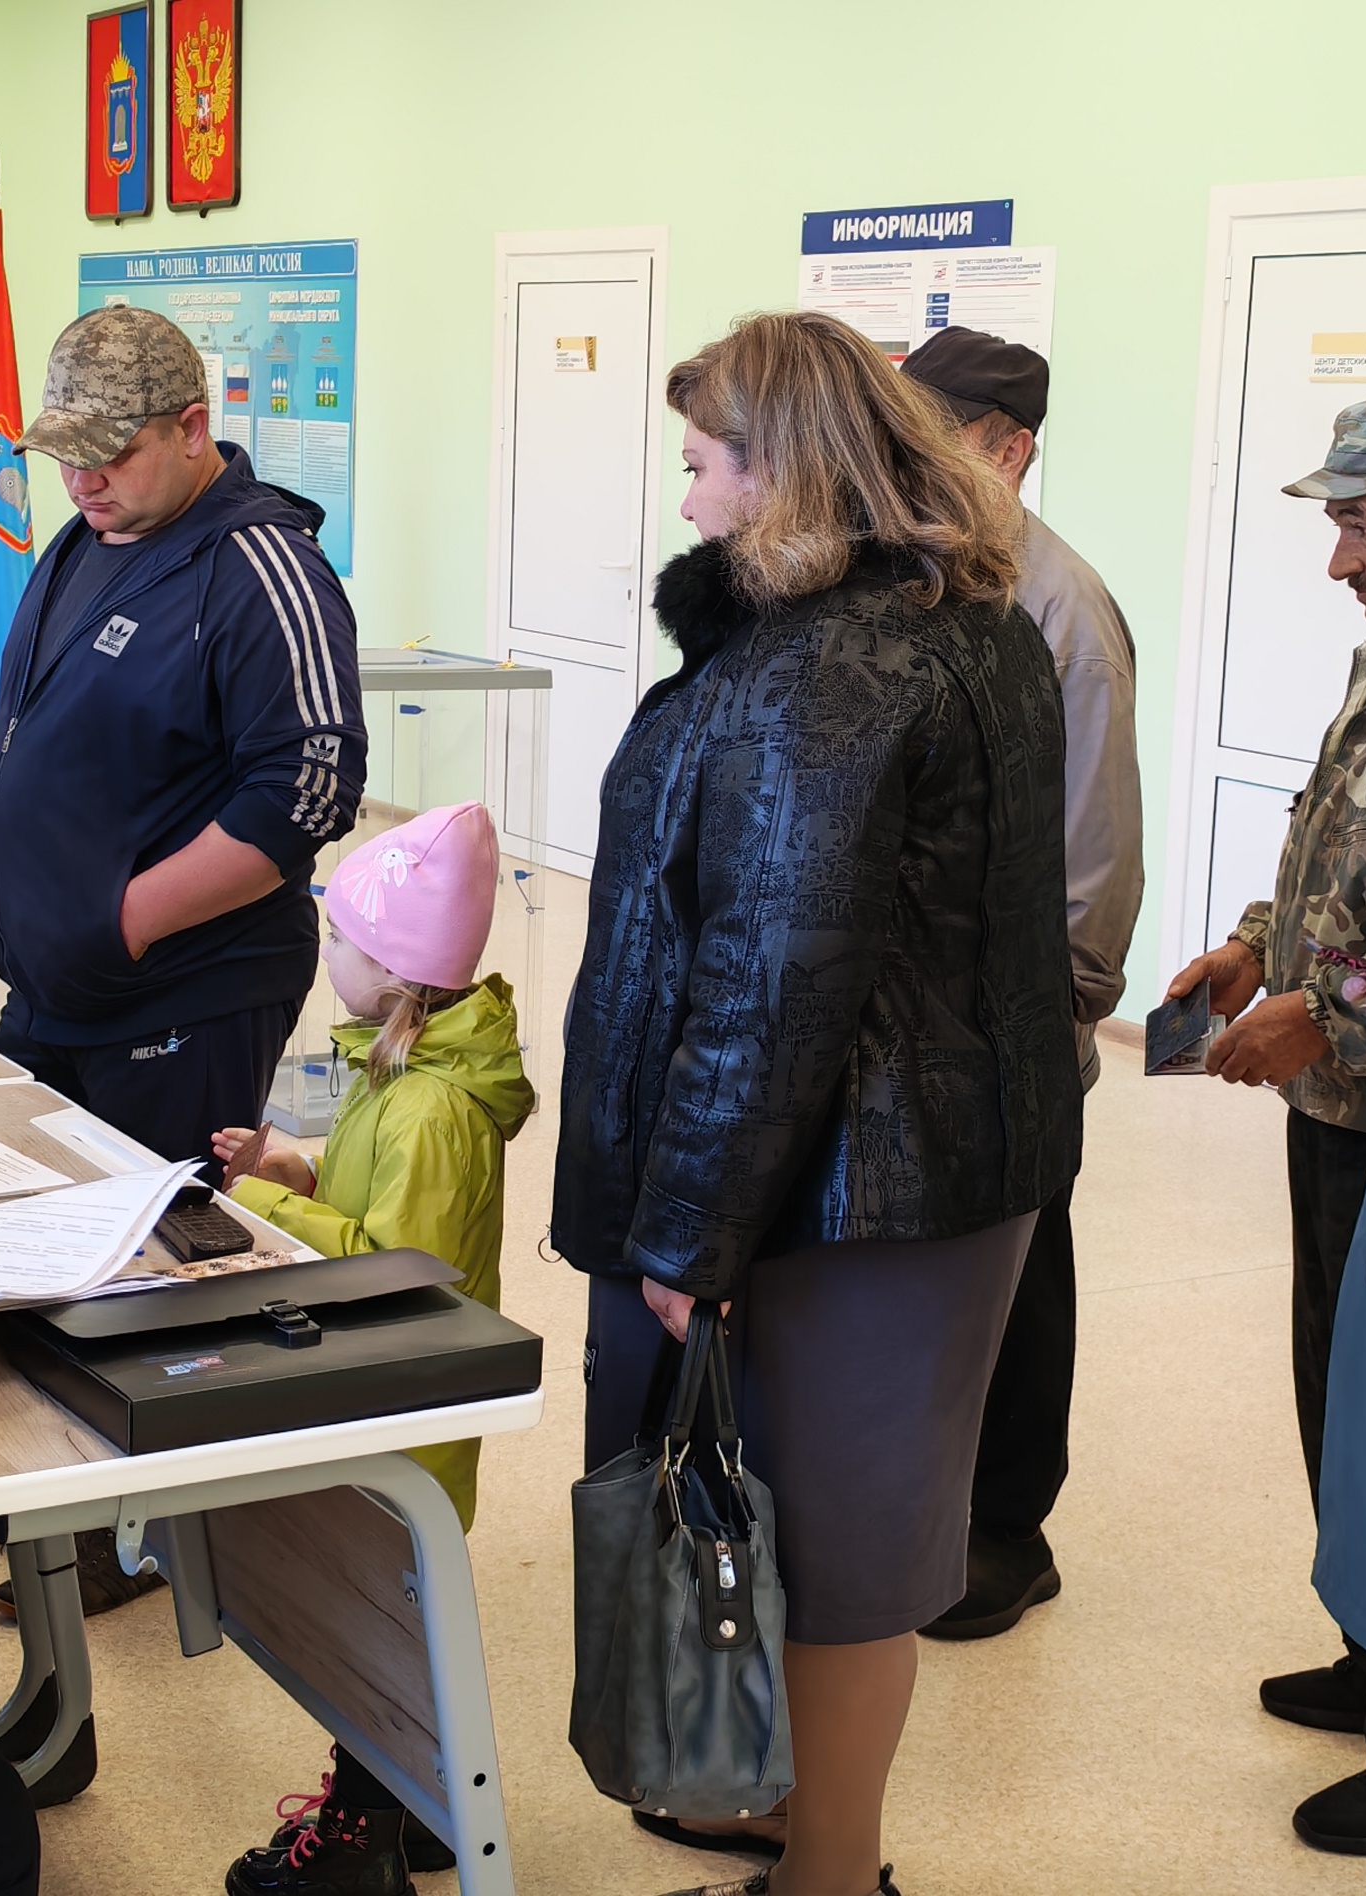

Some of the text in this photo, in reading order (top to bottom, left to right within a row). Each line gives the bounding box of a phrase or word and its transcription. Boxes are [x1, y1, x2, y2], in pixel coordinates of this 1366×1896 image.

[832, 211, 973, 242] ИНФОРМАЦИЯ
[126, 259, 154, 277] НАША
[158, 257, 198, 278] РОДИНА
[205, 254, 253, 275] ВЕЛИКАЯ
[259, 252, 302, 273] РОССИЯ
[99, 639, 120, 651] adidas
[130, 1045, 158, 1060] NIKE
